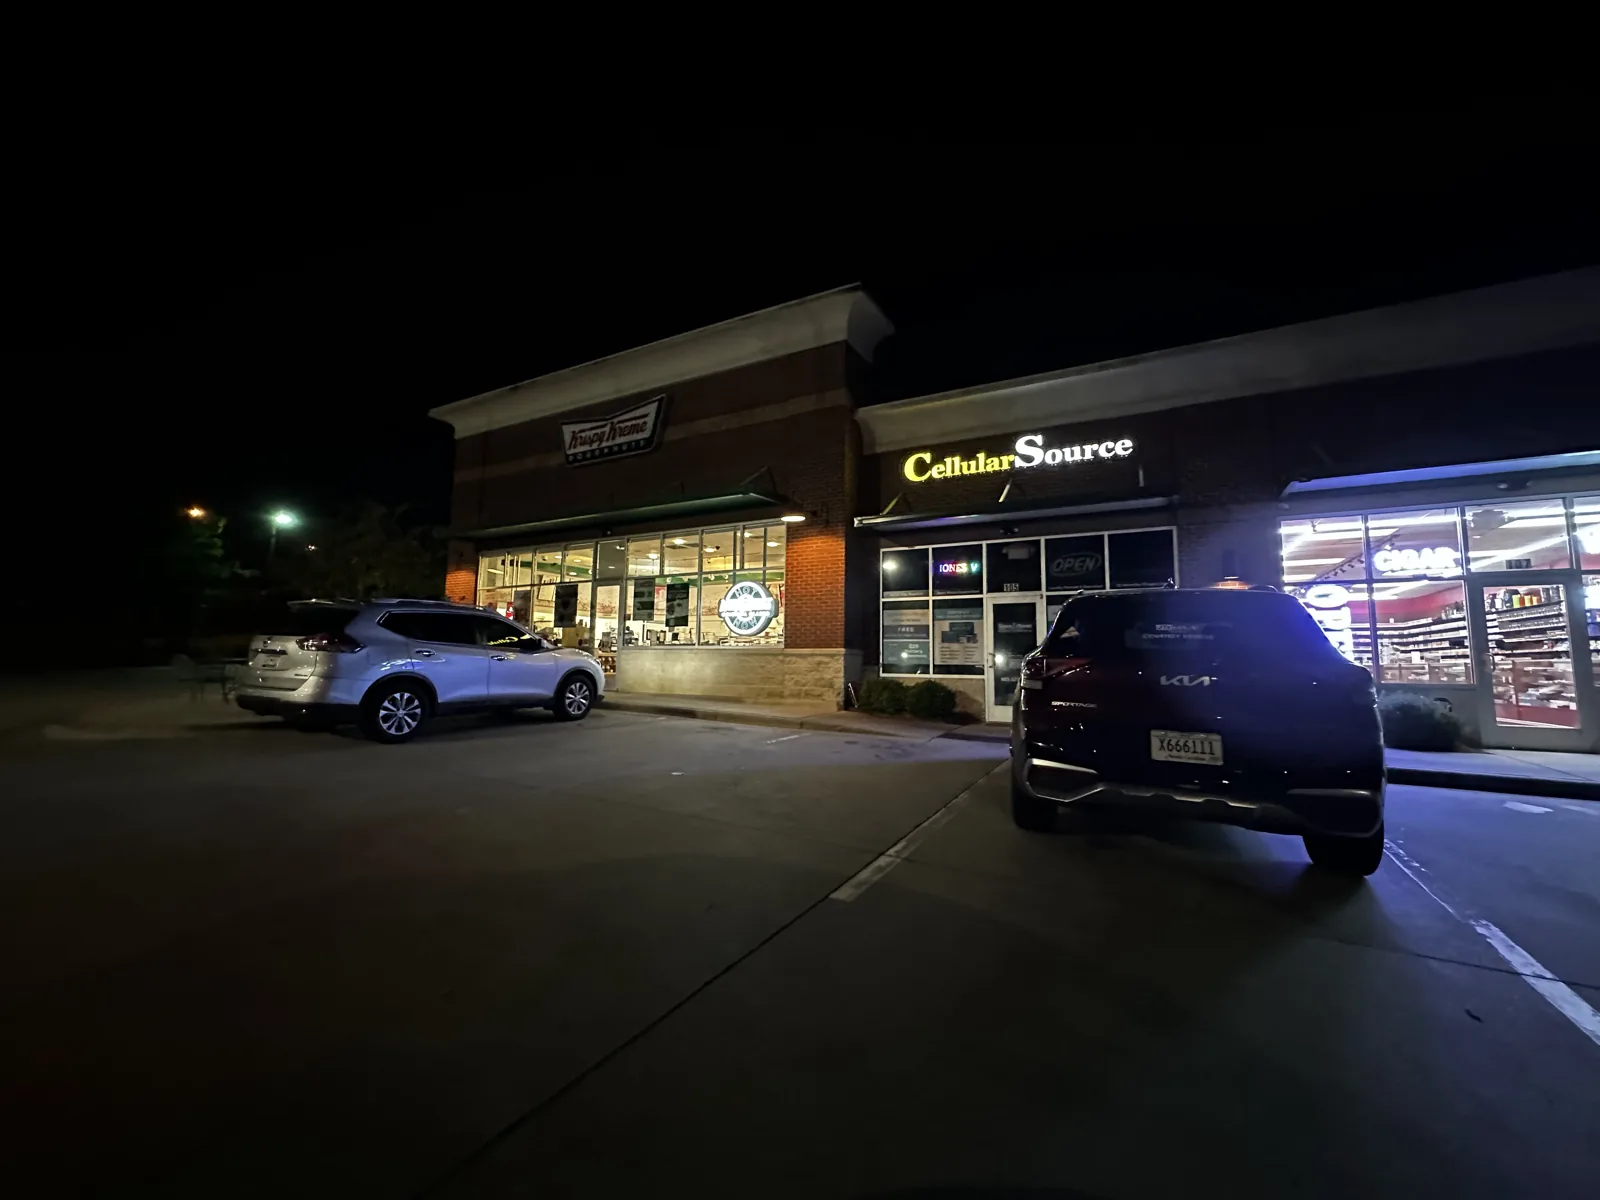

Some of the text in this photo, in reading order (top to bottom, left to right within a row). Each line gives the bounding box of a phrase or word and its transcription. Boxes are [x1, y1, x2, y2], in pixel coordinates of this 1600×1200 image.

[568, 412, 651, 450] Krispy Kreme
[568, 439, 647, 462] DOUGHNUTS
[1053, 555, 1097, 573] OPEN
[734, 586, 759, 598] HOT
[1004, 583, 1019, 592] 105
[733, 616, 757, 630] NOW
[1160, 674, 1211, 687] KIA
[1051, 700, 1098, 708] SPORTAGE
[1159, 738, 1216, 756] X666111
